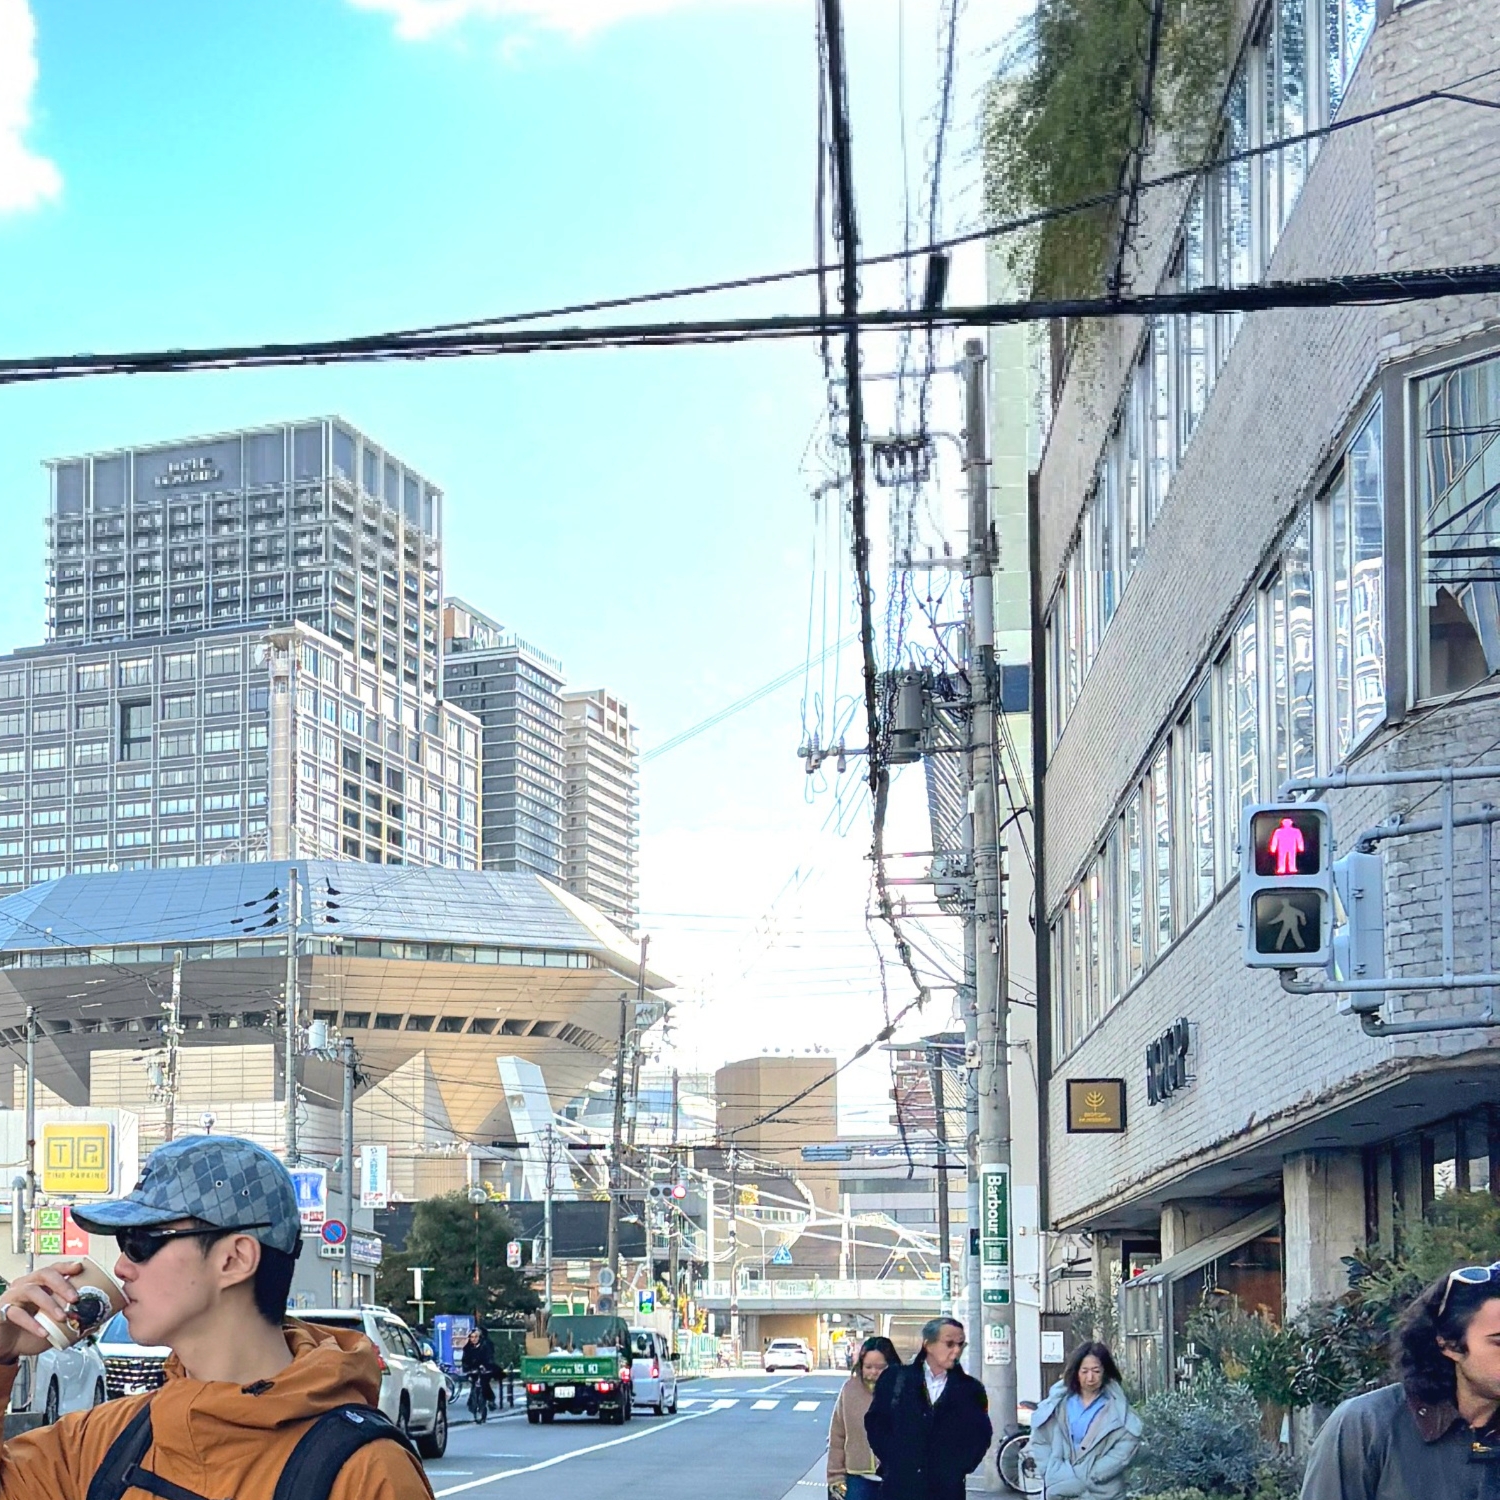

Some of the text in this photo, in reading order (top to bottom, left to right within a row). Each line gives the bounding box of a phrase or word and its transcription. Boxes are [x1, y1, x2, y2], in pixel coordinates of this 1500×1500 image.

[54, 1144, 98, 1163] T P
[987, 1175, 1003, 1235] Barbour
[39, 1208, 61, 1230] 空
[39, 1231, 61, 1254] 空
